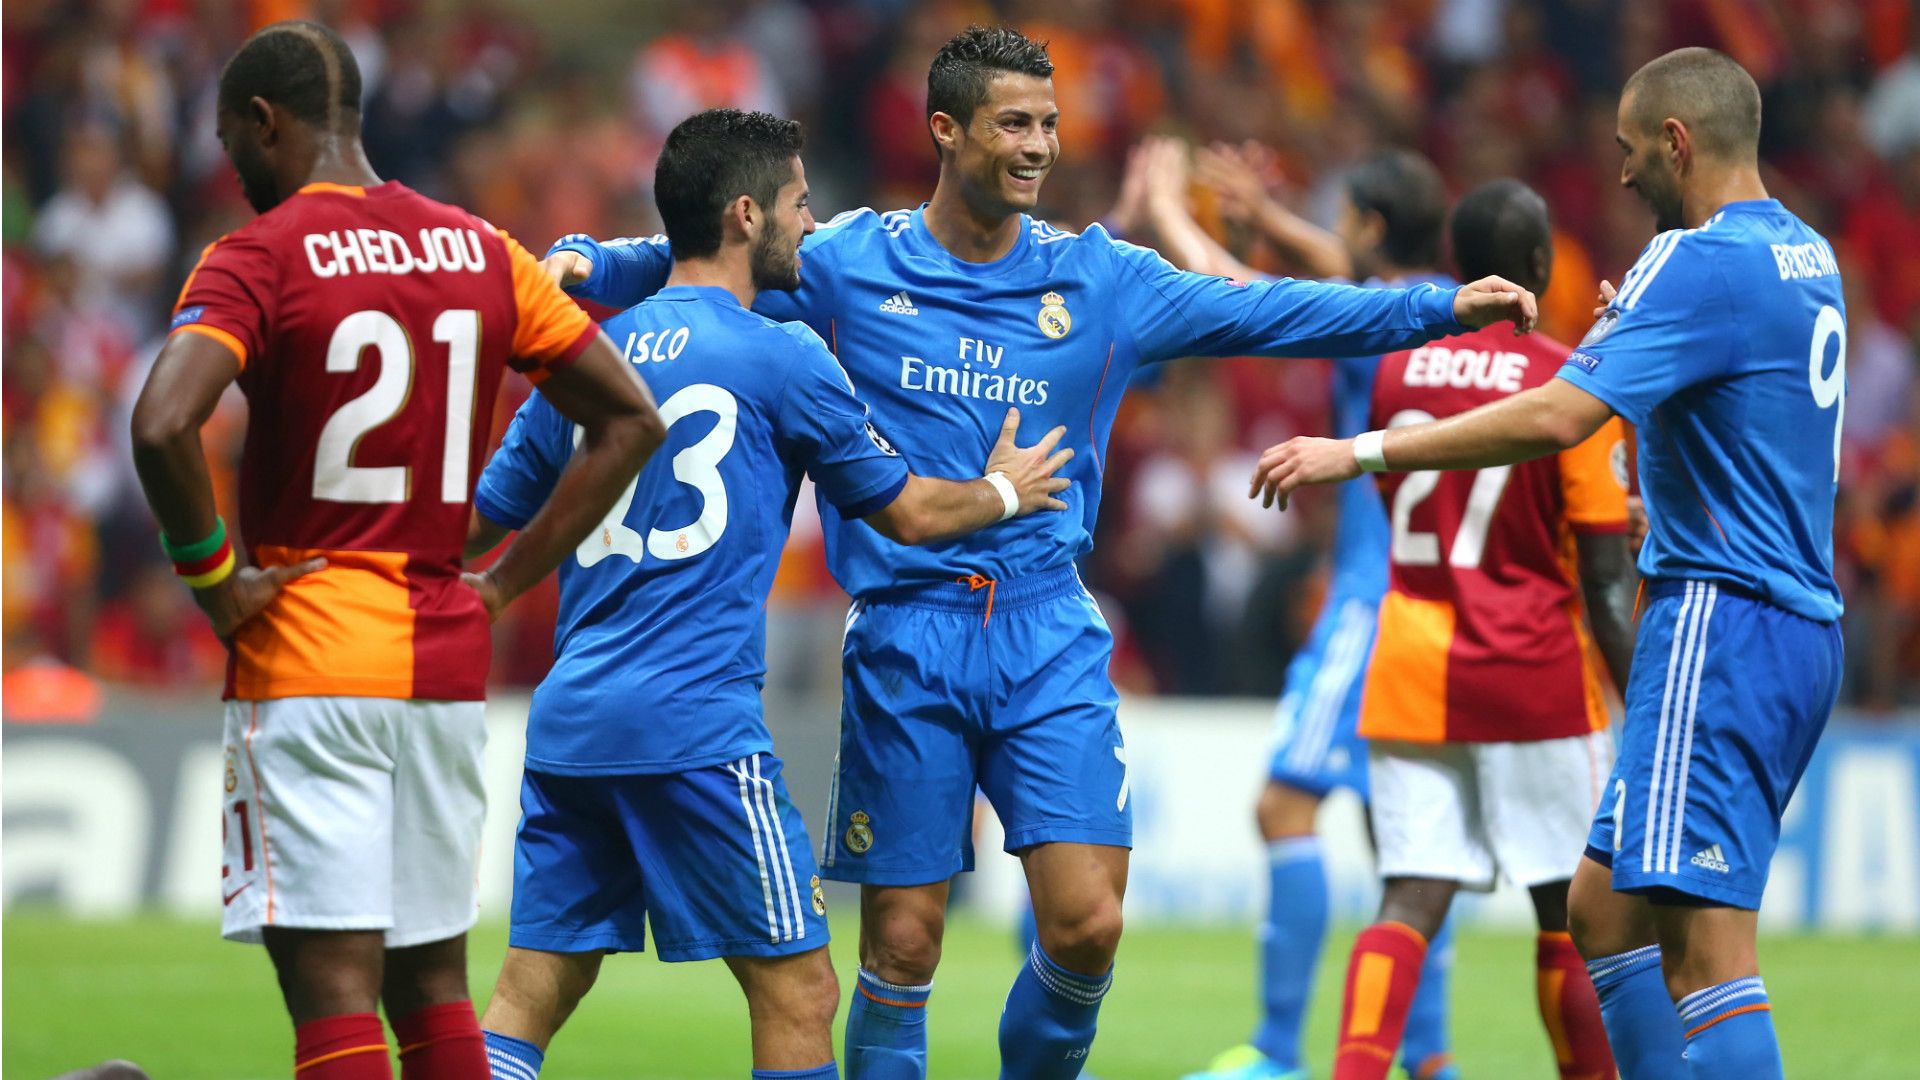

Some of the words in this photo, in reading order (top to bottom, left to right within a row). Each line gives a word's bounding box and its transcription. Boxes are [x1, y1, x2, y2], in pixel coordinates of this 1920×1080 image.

[303, 226, 487, 279] CHEDJOU
[879, 303, 919, 316] adidas
[624, 326, 690, 365] ISCO
[959, 337, 1004, 369] Fly
[901, 356, 1049, 406] Emirates
[1403, 346, 1529, 392] EBOUE
[312, 309, 481, 503] 21
[1809, 304, 1847, 484] 9
[1690, 856, 1730, 874] adidas
